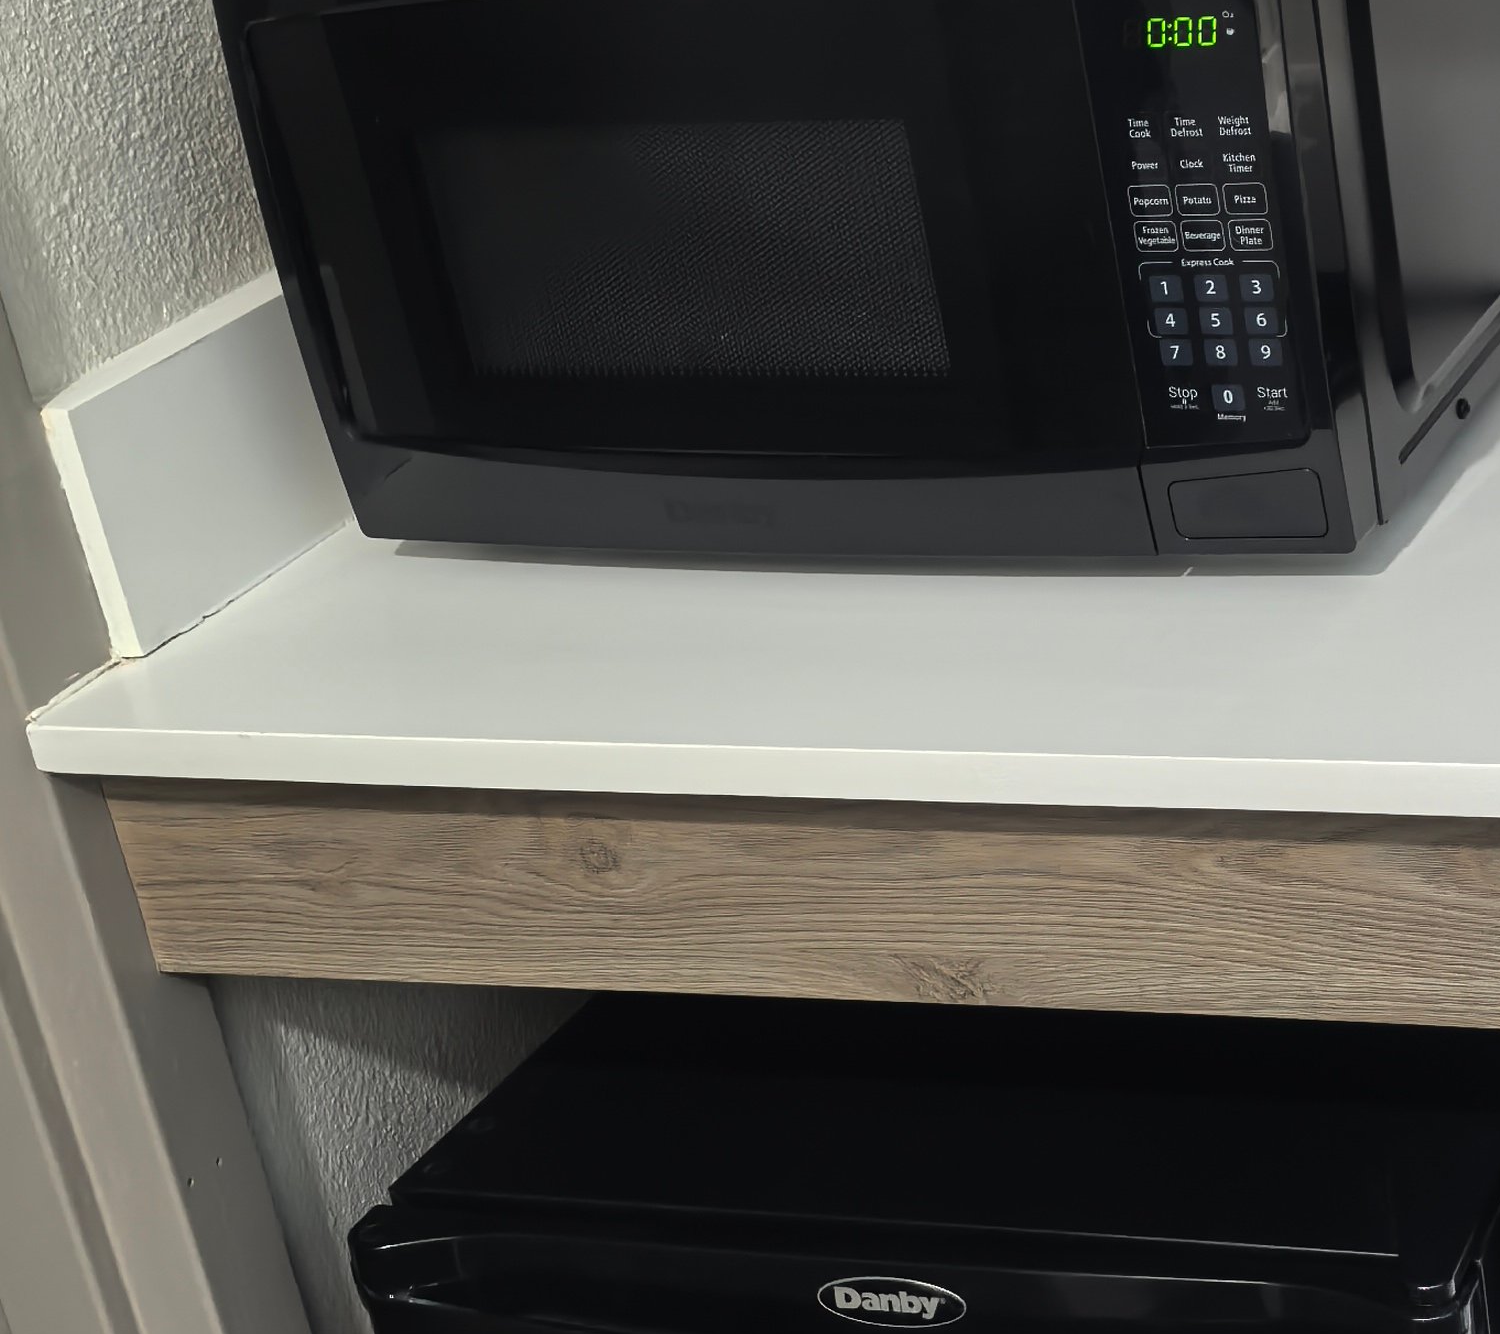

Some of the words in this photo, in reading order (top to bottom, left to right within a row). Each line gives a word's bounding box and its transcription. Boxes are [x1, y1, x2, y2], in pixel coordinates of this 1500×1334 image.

[1147, 16, 1217, 48] 0:00
[1128, 118, 1149, 128] Time
[1174, 117, 1196, 127] Time
[1218, 115, 1250, 127] Weight
[1129, 128, 1151, 139] Cook
[1170, 127, 1203, 137] Defrost
[1219, 126, 1252, 136] Defrost
[1222, 153, 1256, 163] Kitchen
[1131, 161, 1158, 170] Power
[1179, 159, 1204, 169] Clock
[1228, 163, 1253, 173] Timer
[1133, 196, 1169, 208] Popcorn
[1182, 195, 1212, 205] Potato
[1234, 195, 1257, 205] Pizza
[1142, 226, 1169, 234] Frozen
[1235, 225, 1264, 235] Dinner
[1138, 236, 1176, 247] Vegetable
[1184, 231, 1221, 242] Beverage
[1240, 236, 1263, 245] Plate
[1181, 258, 1212, 267] Express
[1213, 258, 1235, 266] Cook
[1160, 281, 1168, 295] 1
[1205, 280, 1217, 295] 2
[1251, 280, 1262, 295] 3
[1165, 313, 1176, 327] 4
[1211, 313, 1221, 327] 5
[1256, 313, 1267, 327] 6
[1170, 345, 1180, 359] 7
[1215, 345, 1226, 359] 8
[1260, 345, 1271, 359] 9
[1168, 386, 1198, 400] Stop
[1223, 389, 1233, 404] 0
[1257, 386, 1288, 398] Start
[833, 1286, 940, 1319] Danby
